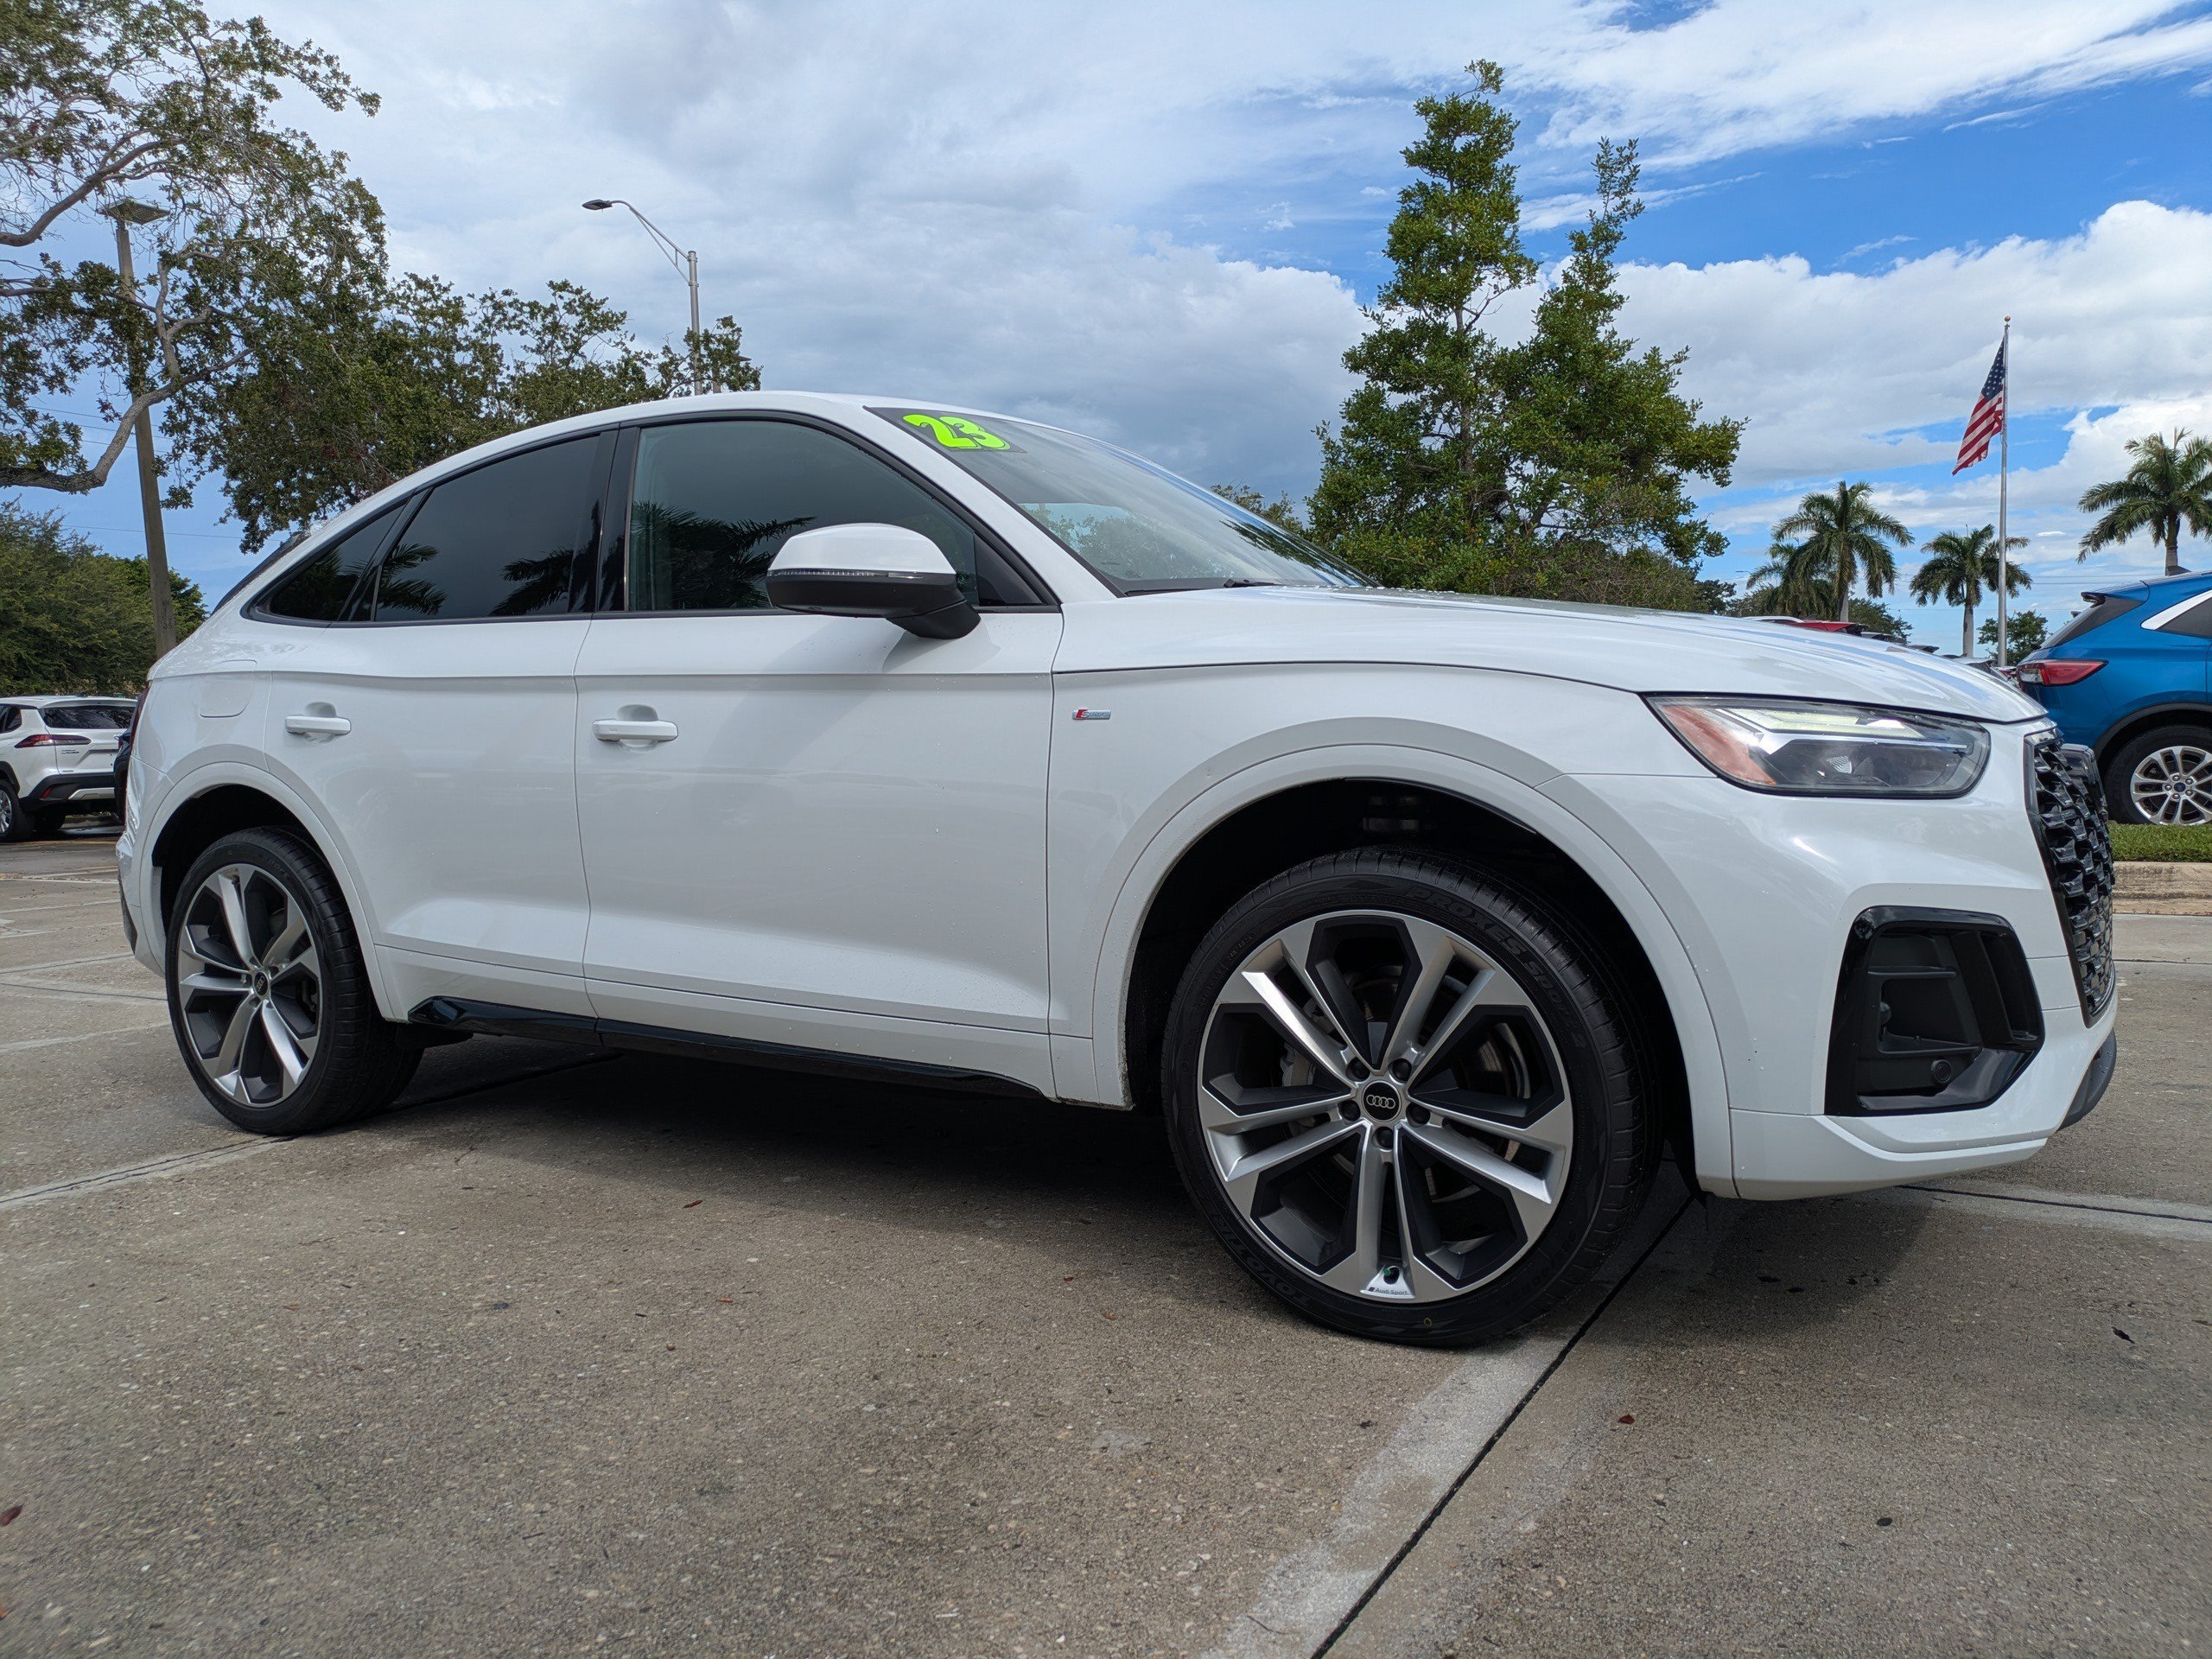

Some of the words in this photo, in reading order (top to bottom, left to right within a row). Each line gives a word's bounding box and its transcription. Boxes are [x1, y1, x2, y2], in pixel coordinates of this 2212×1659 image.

[902, 413, 1011, 451] 23
[1407, 886, 1528, 957] PROXES
[1244, 1256, 1310, 1306] TOYO
